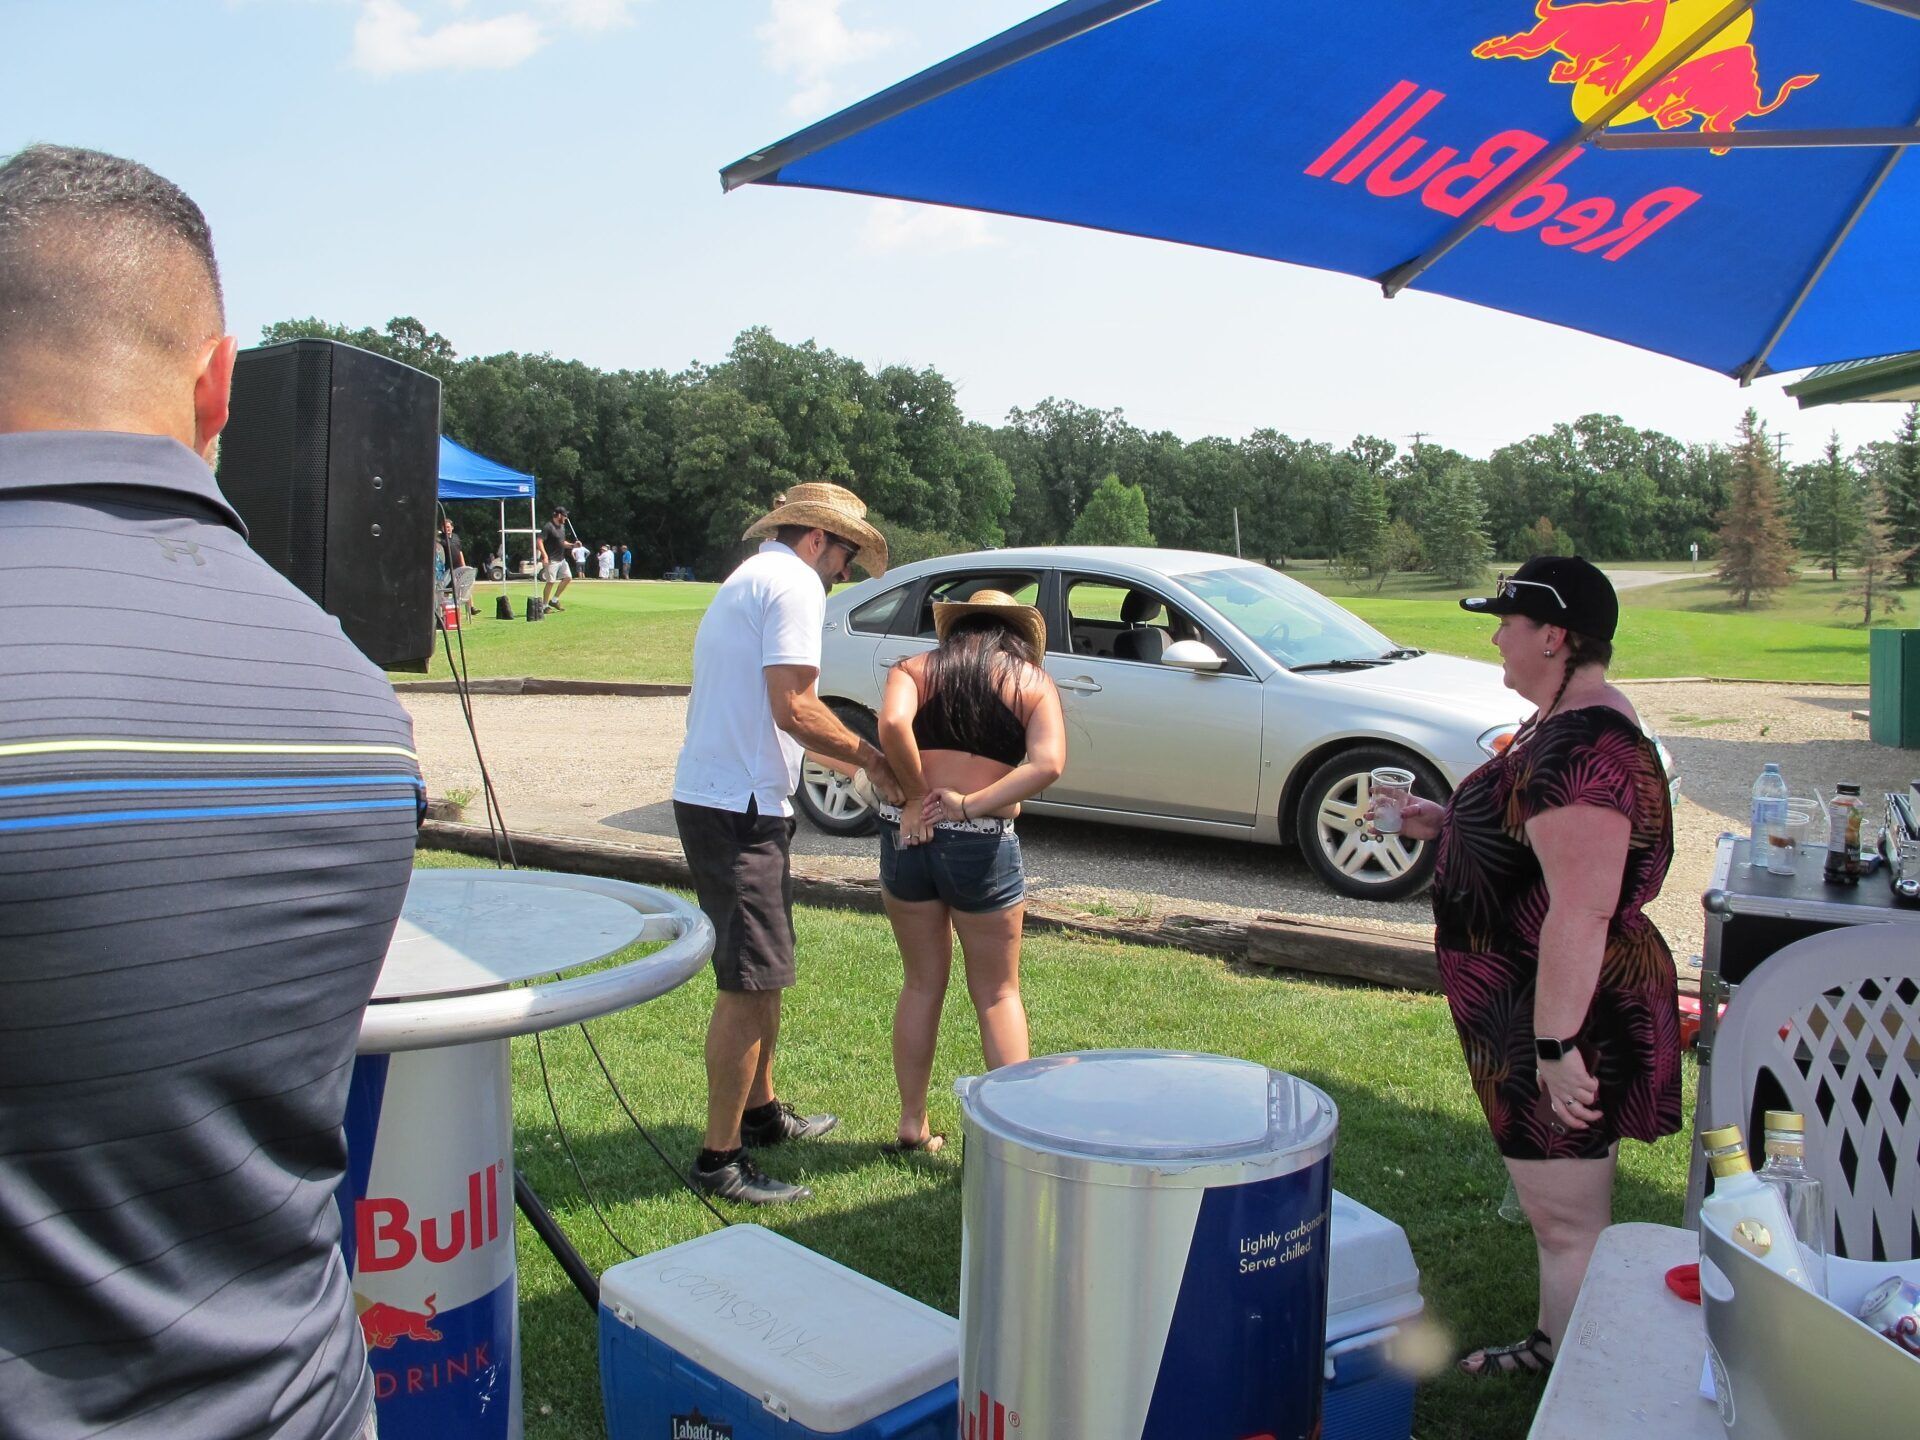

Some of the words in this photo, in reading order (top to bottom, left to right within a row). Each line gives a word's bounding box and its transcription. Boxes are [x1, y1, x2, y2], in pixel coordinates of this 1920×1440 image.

[355, 1163, 499, 1274] Bull
[1239, 1256, 1276, 1274] Serve
[1279, 1235, 1313, 1263] chilled.
[1240, 1230, 1282, 1256] Lightly
[375, 1341, 490, 1399] DRINK
[672, 1417, 709, 1440] Labatt
